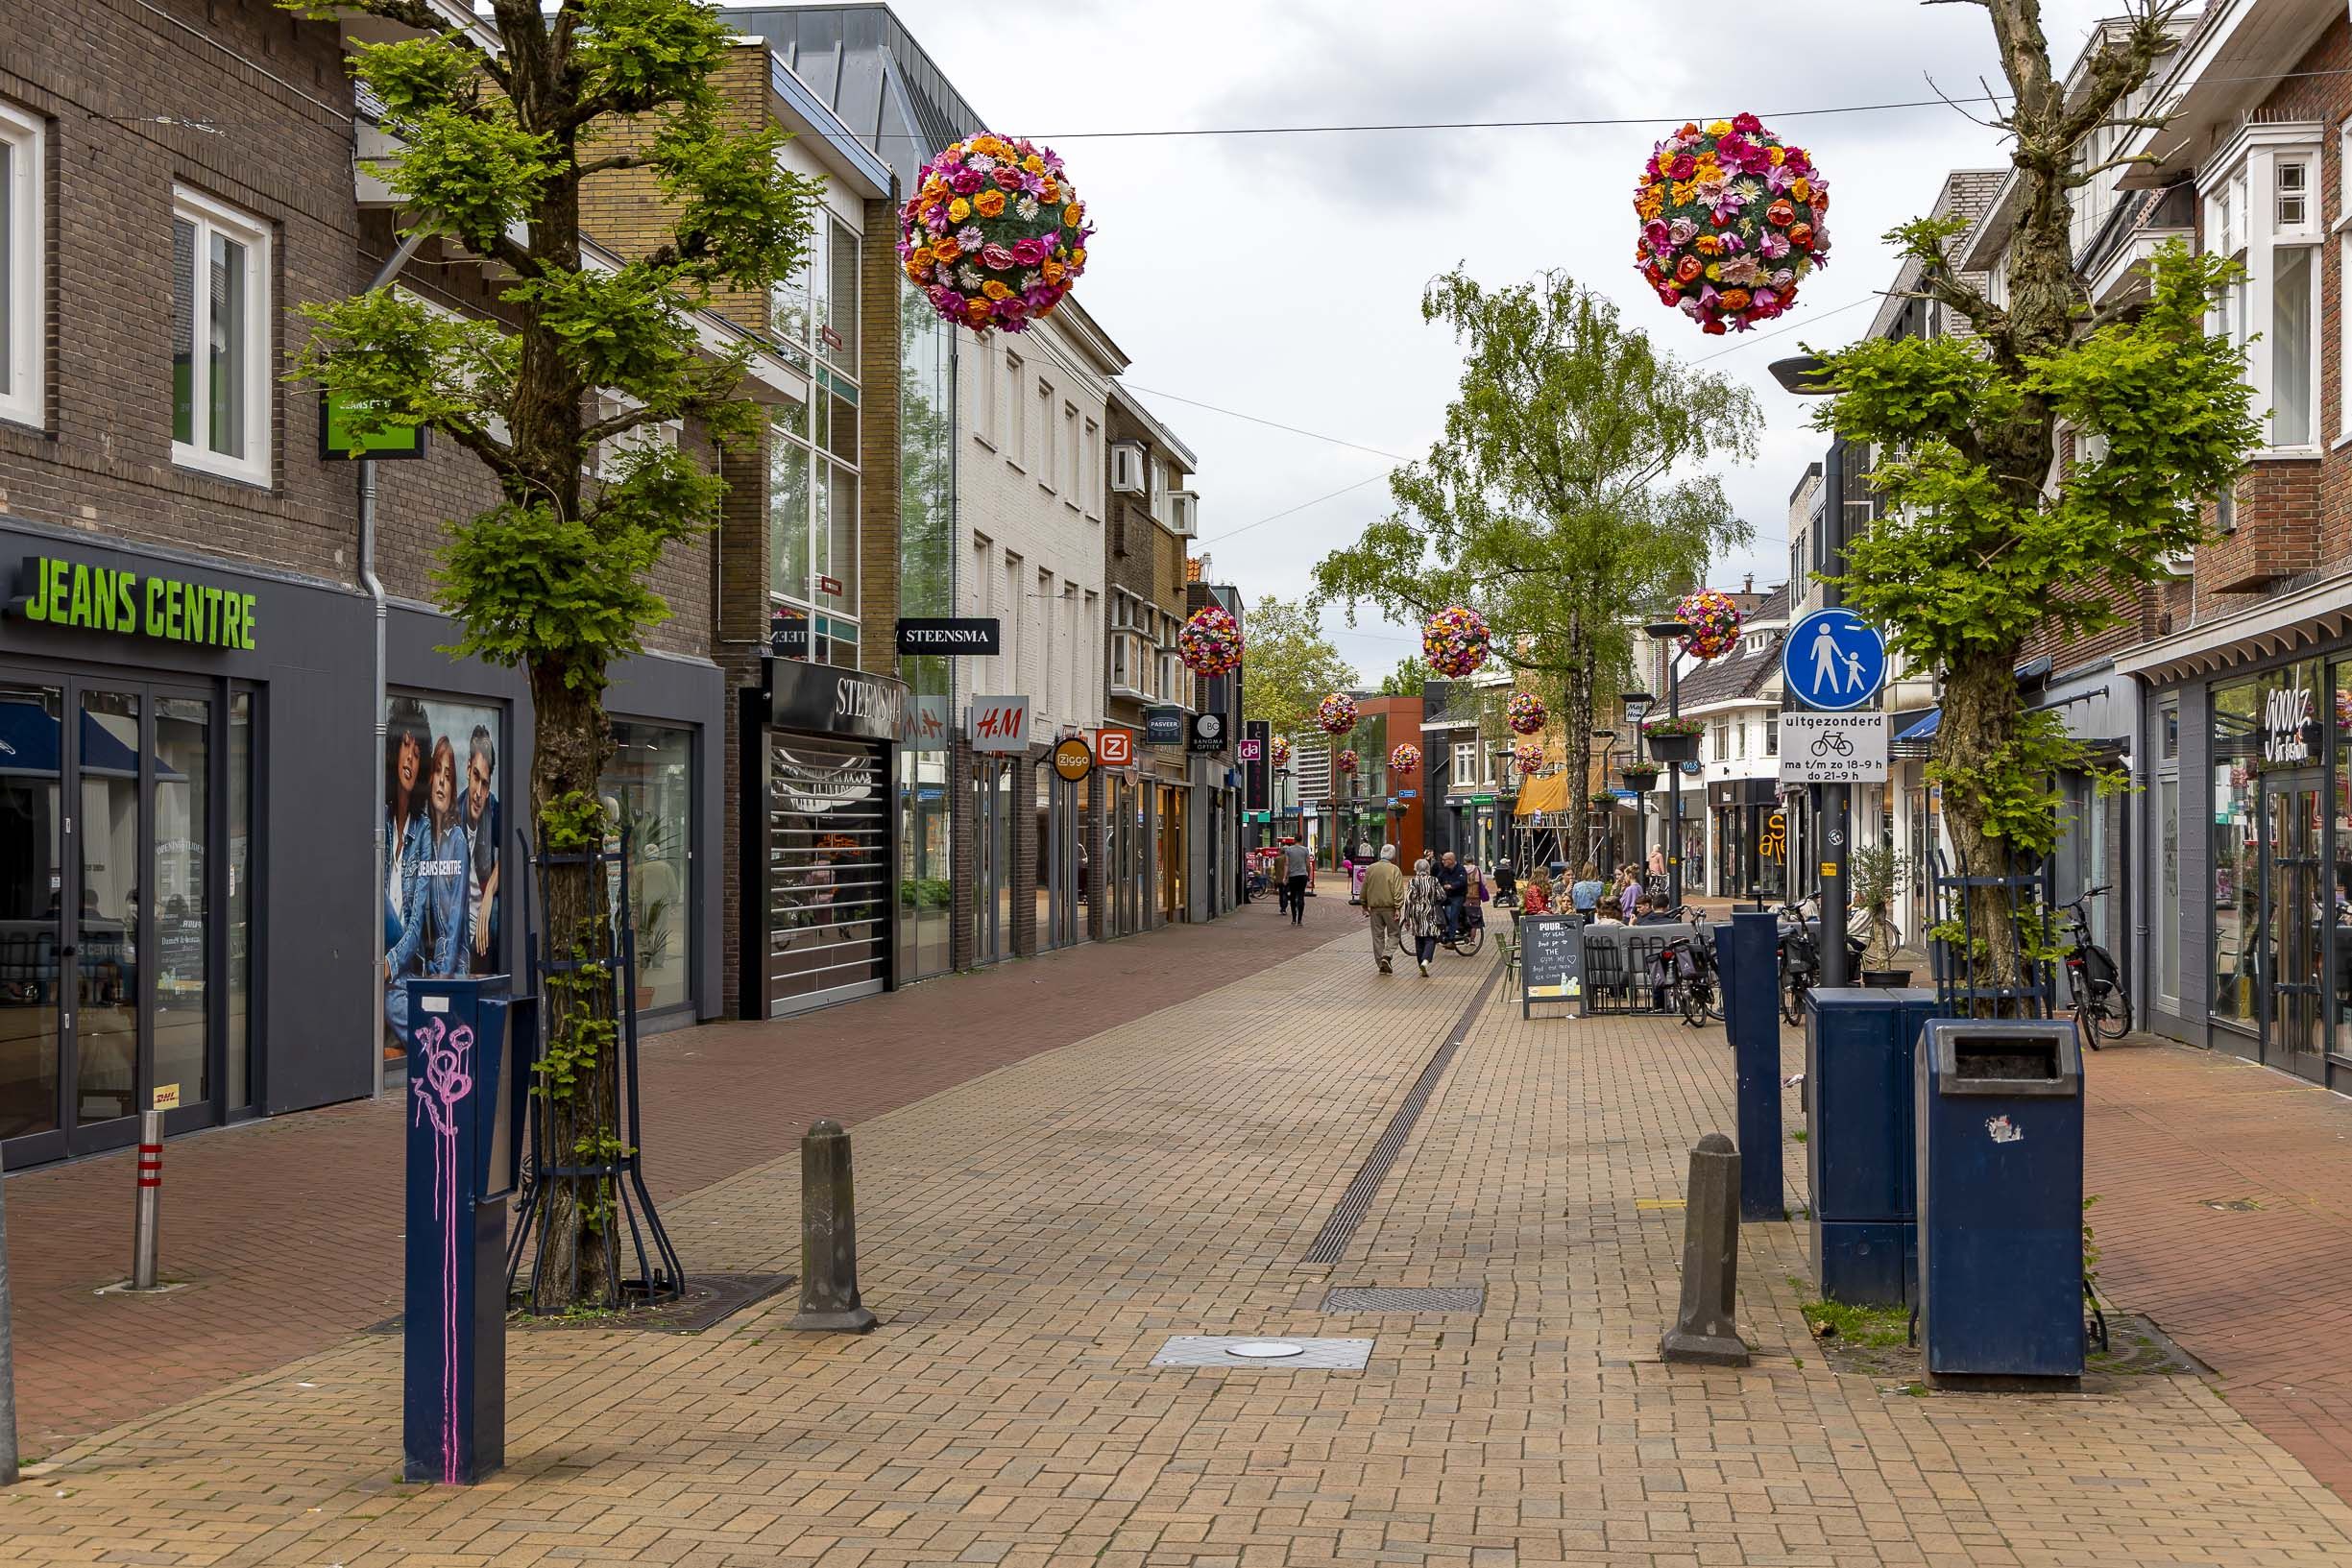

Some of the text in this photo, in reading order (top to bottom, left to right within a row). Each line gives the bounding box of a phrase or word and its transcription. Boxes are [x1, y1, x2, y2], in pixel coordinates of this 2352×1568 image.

[26, 556, 256, 650] JEANS CENTRE
[906, 630, 988, 643] STEENSMA
[836, 677, 901, 723] STEENSMA
[977, 707, 1023, 739] H&M
[1786, 716, 1881, 730] uitgezonderd
[1243, 743, 1258, 758] da
[1057, 753, 1088, 766] Ziggo
[1806, 760, 1826, 769] t/m
[1847, 760, 1872, 769] 18-9
[1876, 760, 1882, 769] h
[418, 860, 461, 877] JEANS CENTRE
[157, 1092, 175, 1103] DHL
